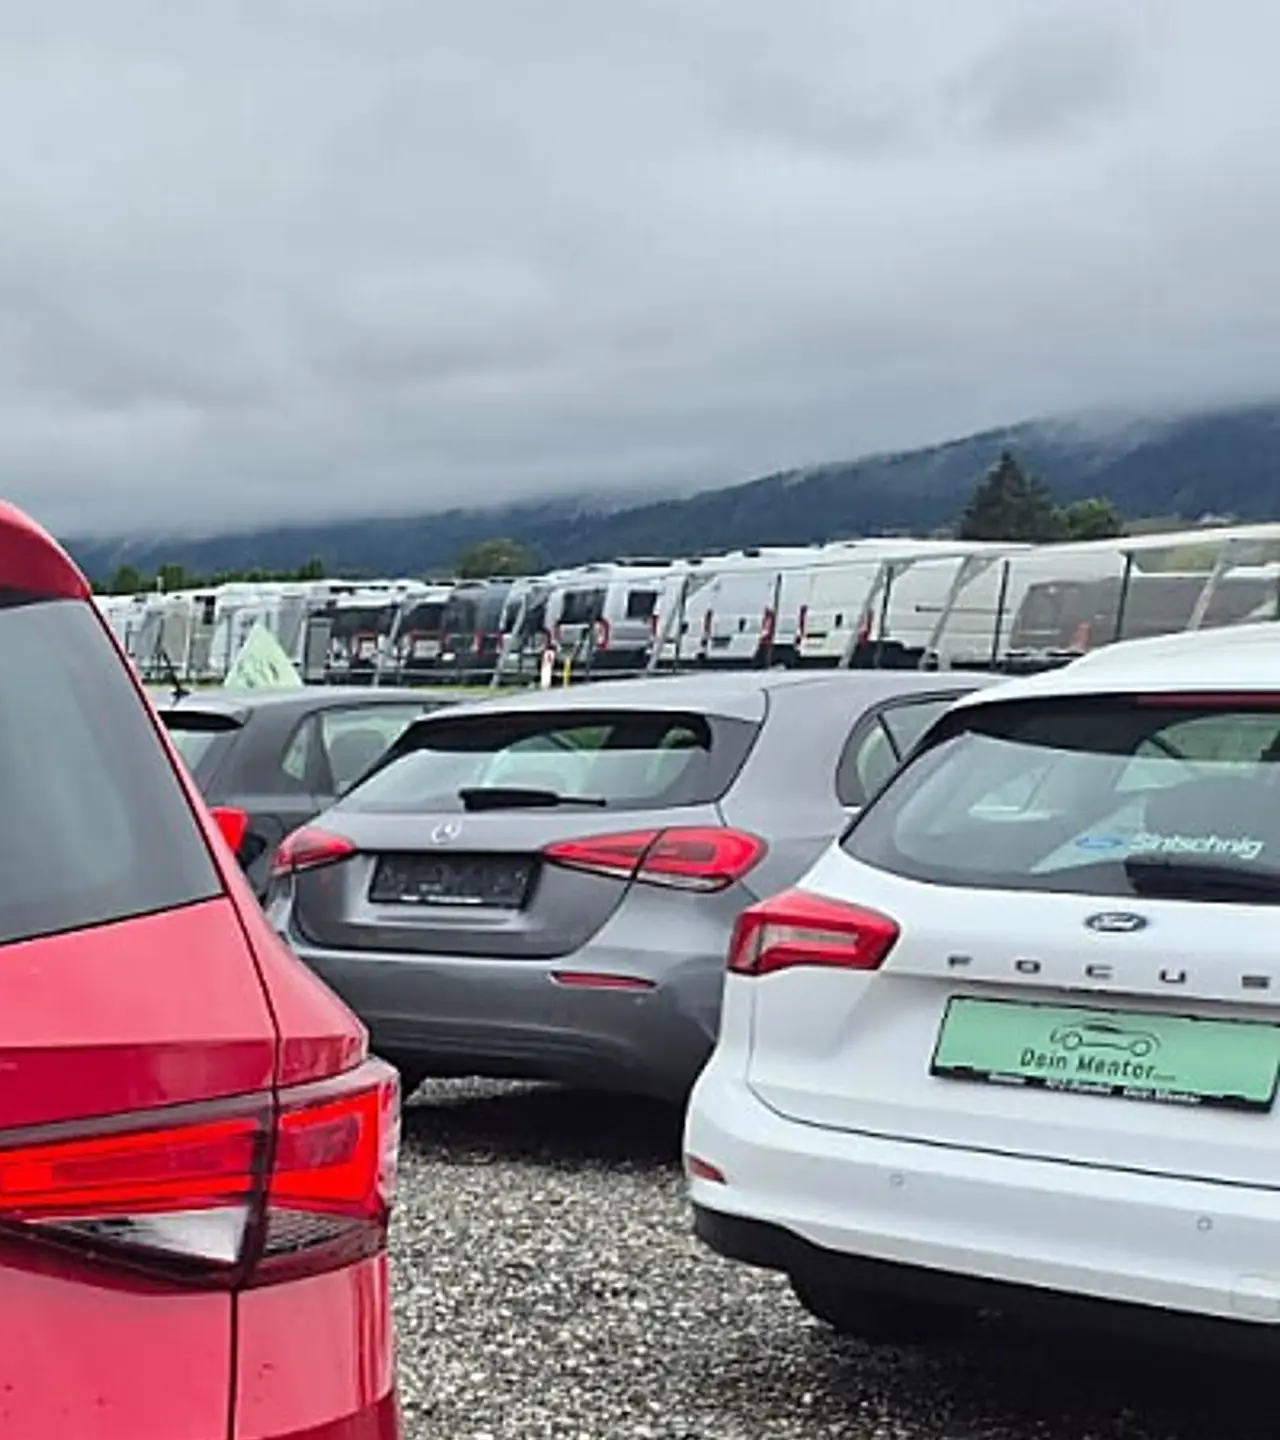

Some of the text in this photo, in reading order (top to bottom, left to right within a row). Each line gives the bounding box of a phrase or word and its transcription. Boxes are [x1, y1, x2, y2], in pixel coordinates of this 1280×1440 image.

[948, 955, 1272, 989] FOCUS
[1019, 1047, 1157, 1079] Dein Mentor
